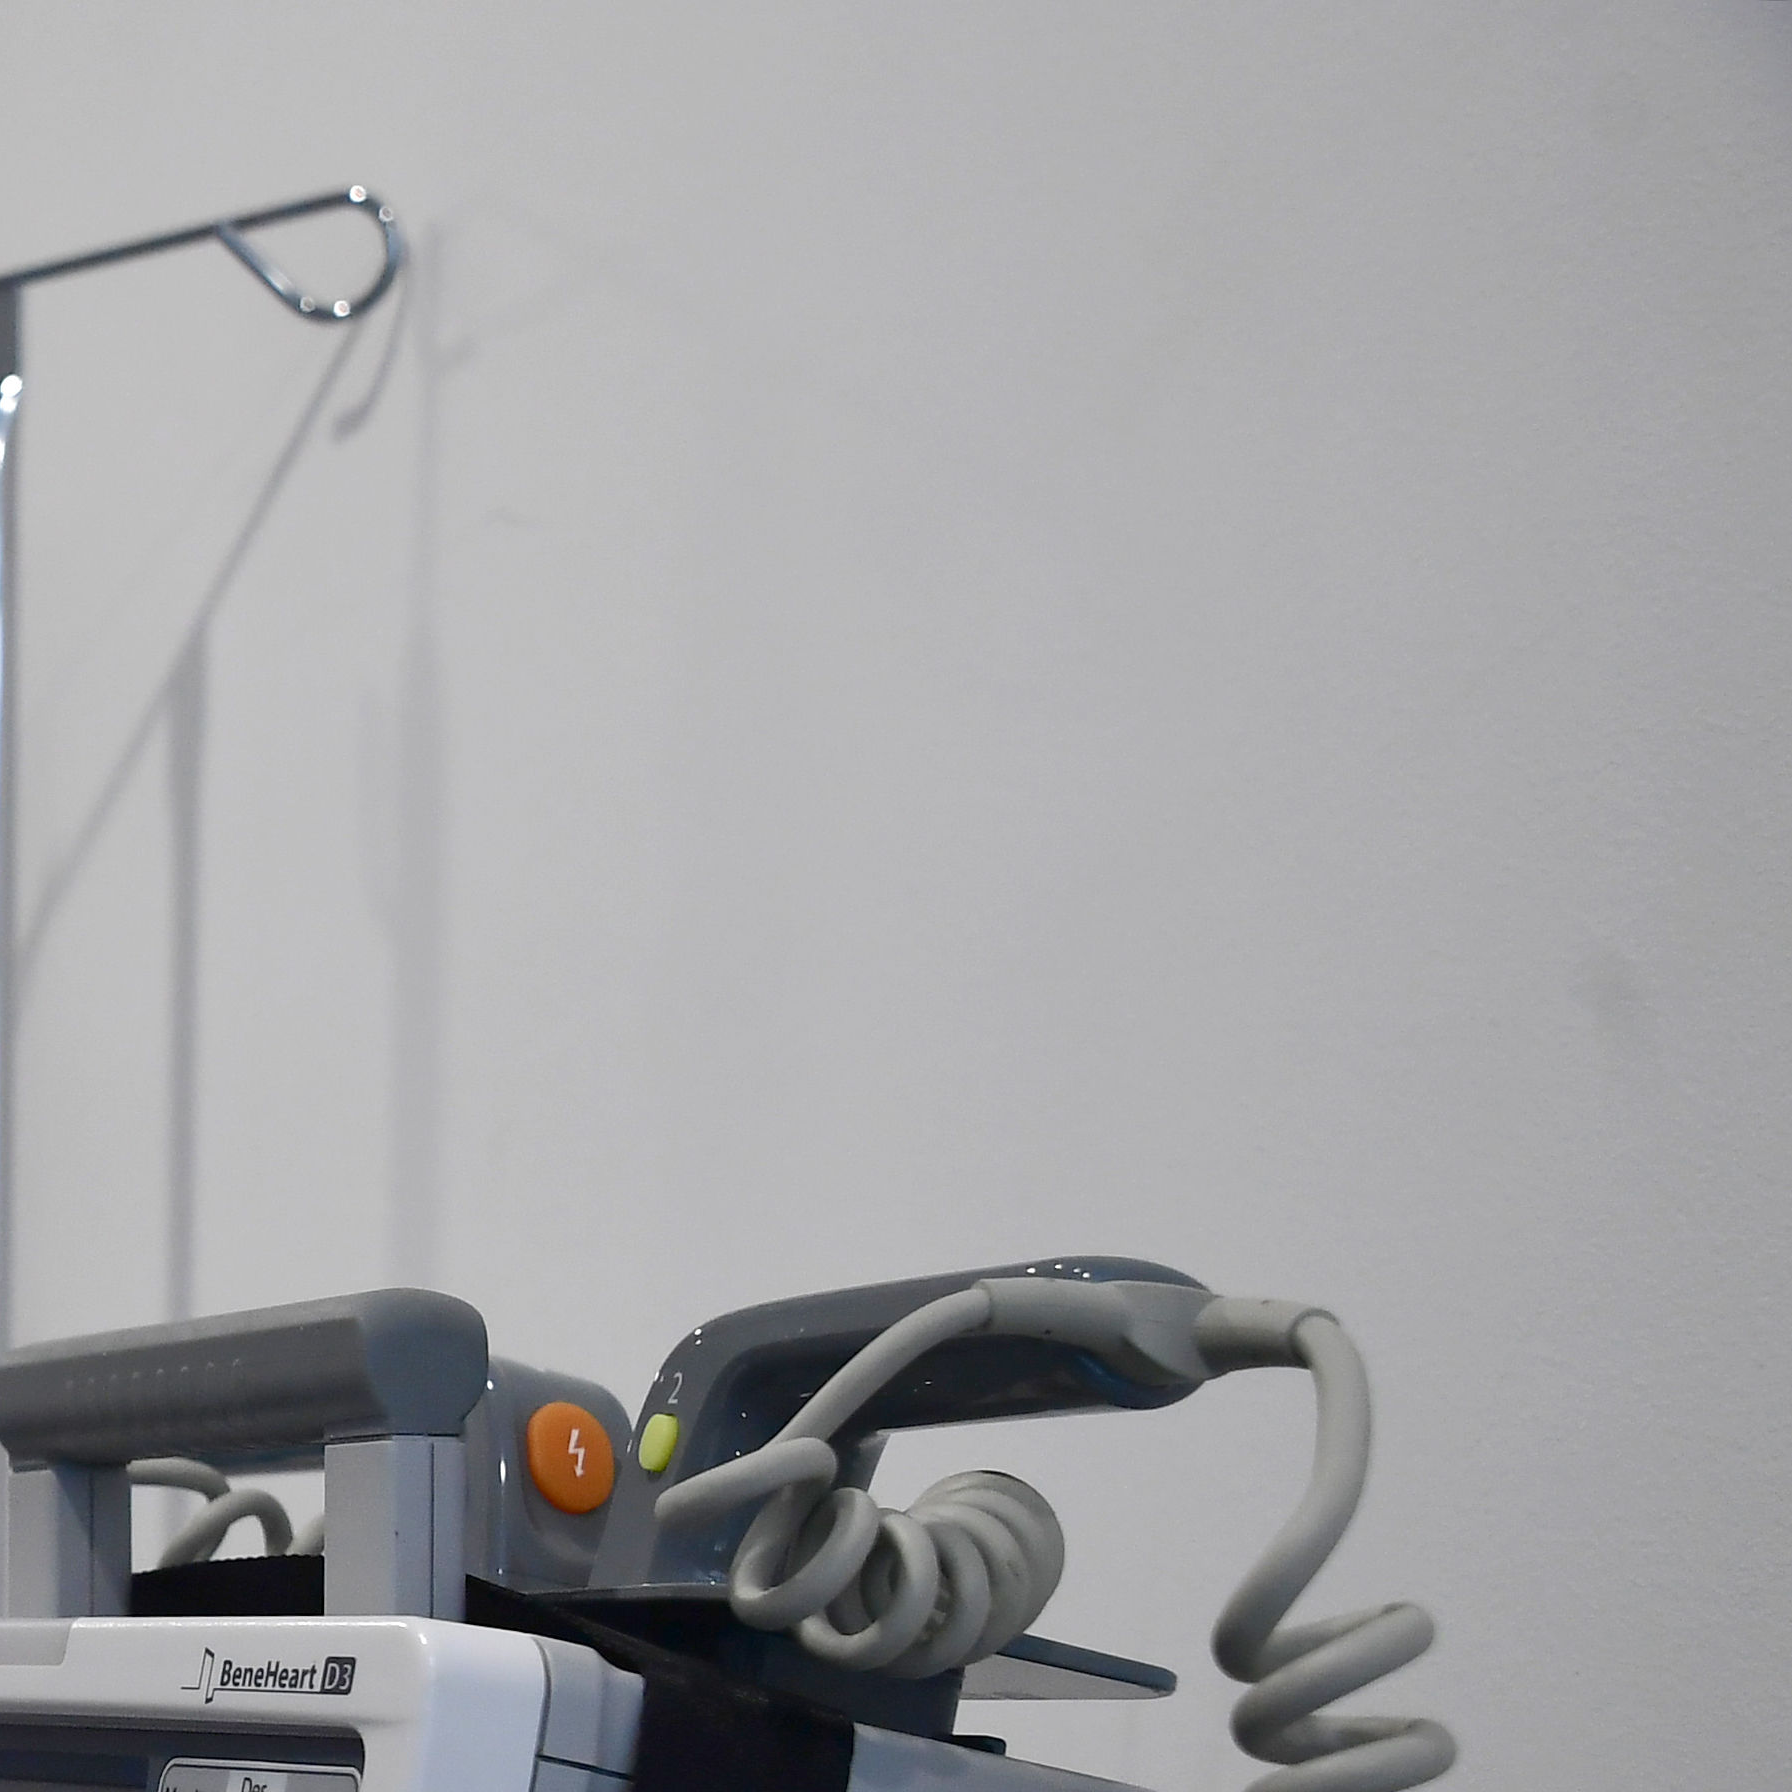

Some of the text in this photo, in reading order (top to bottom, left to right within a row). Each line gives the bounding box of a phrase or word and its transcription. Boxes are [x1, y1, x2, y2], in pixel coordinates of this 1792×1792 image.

[667, 1371, 683, 1405] 2
[219, 1658, 352, 1692] BeneHeart D3
